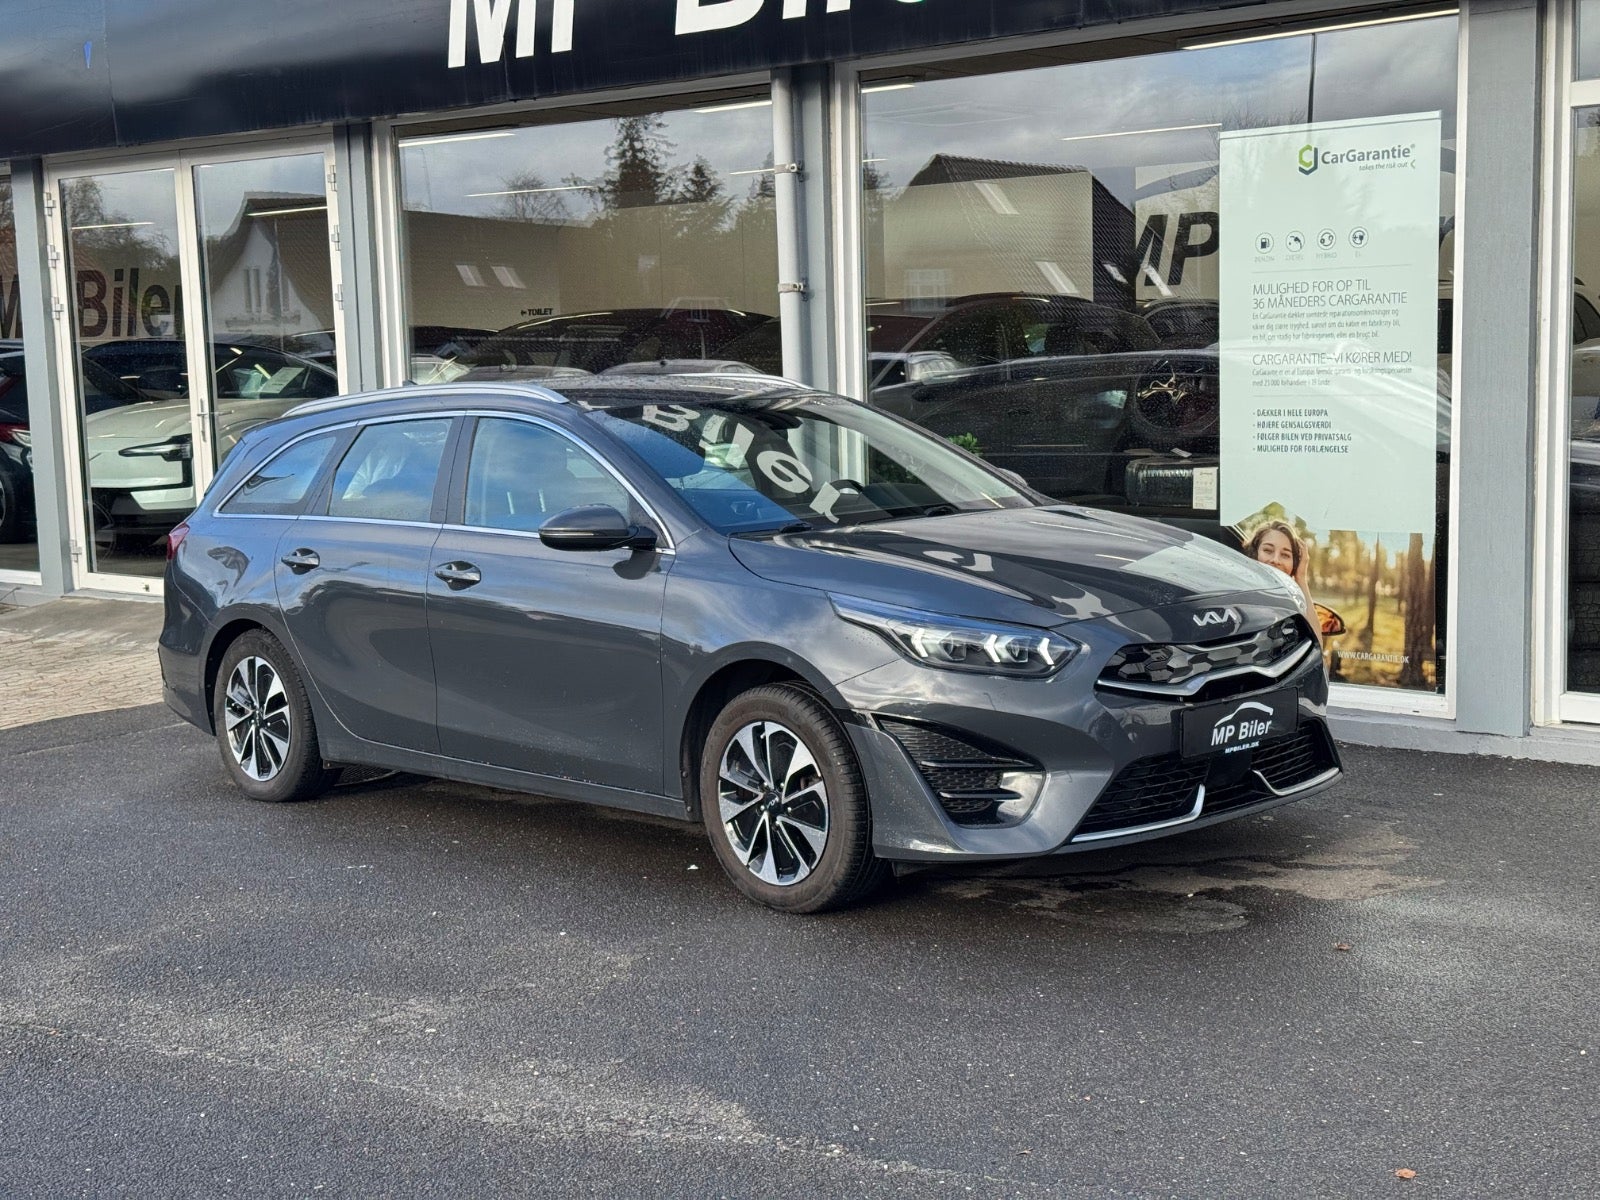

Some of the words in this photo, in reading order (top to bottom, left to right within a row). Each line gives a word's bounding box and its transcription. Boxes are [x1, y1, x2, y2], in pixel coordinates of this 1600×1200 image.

[1321, 145, 1411, 164] CarGarantie
[1253, 282, 1309, 295] MULIGHED
[1312, 281, 1334, 292] FOR
[1336, 280, 1352, 292] OP
[1355, 279, 1371, 291] TIL
[1252, 298, 1265, 309] 36
[1268, 294, 1326, 308] MÅNEDERS
[1329, 292, 1408, 306] CARGARANTIE
[528, 308, 553, 316] TOILET
[1345, 352, 1380, 363] KØRER
[1384, 351, 1412, 363] MED!
[1257, 409, 1281, 417] DÆKKER
[1304, 409, 1329, 417] EUROPA
[1257, 421, 1279, 429] HØJERE
[1281, 421, 1332, 429] GENSALGSVÆRDI
[1314, 433, 1352, 441] PRIVATSALG
[1257, 445, 1289, 453] MULIGHED
[1290, 445, 1303, 453] FOR
[1304, 445, 1349, 453] FORLÆNGELSE
[1211, 725, 1235, 746] MP
[1238, 719, 1272, 740] Biler
